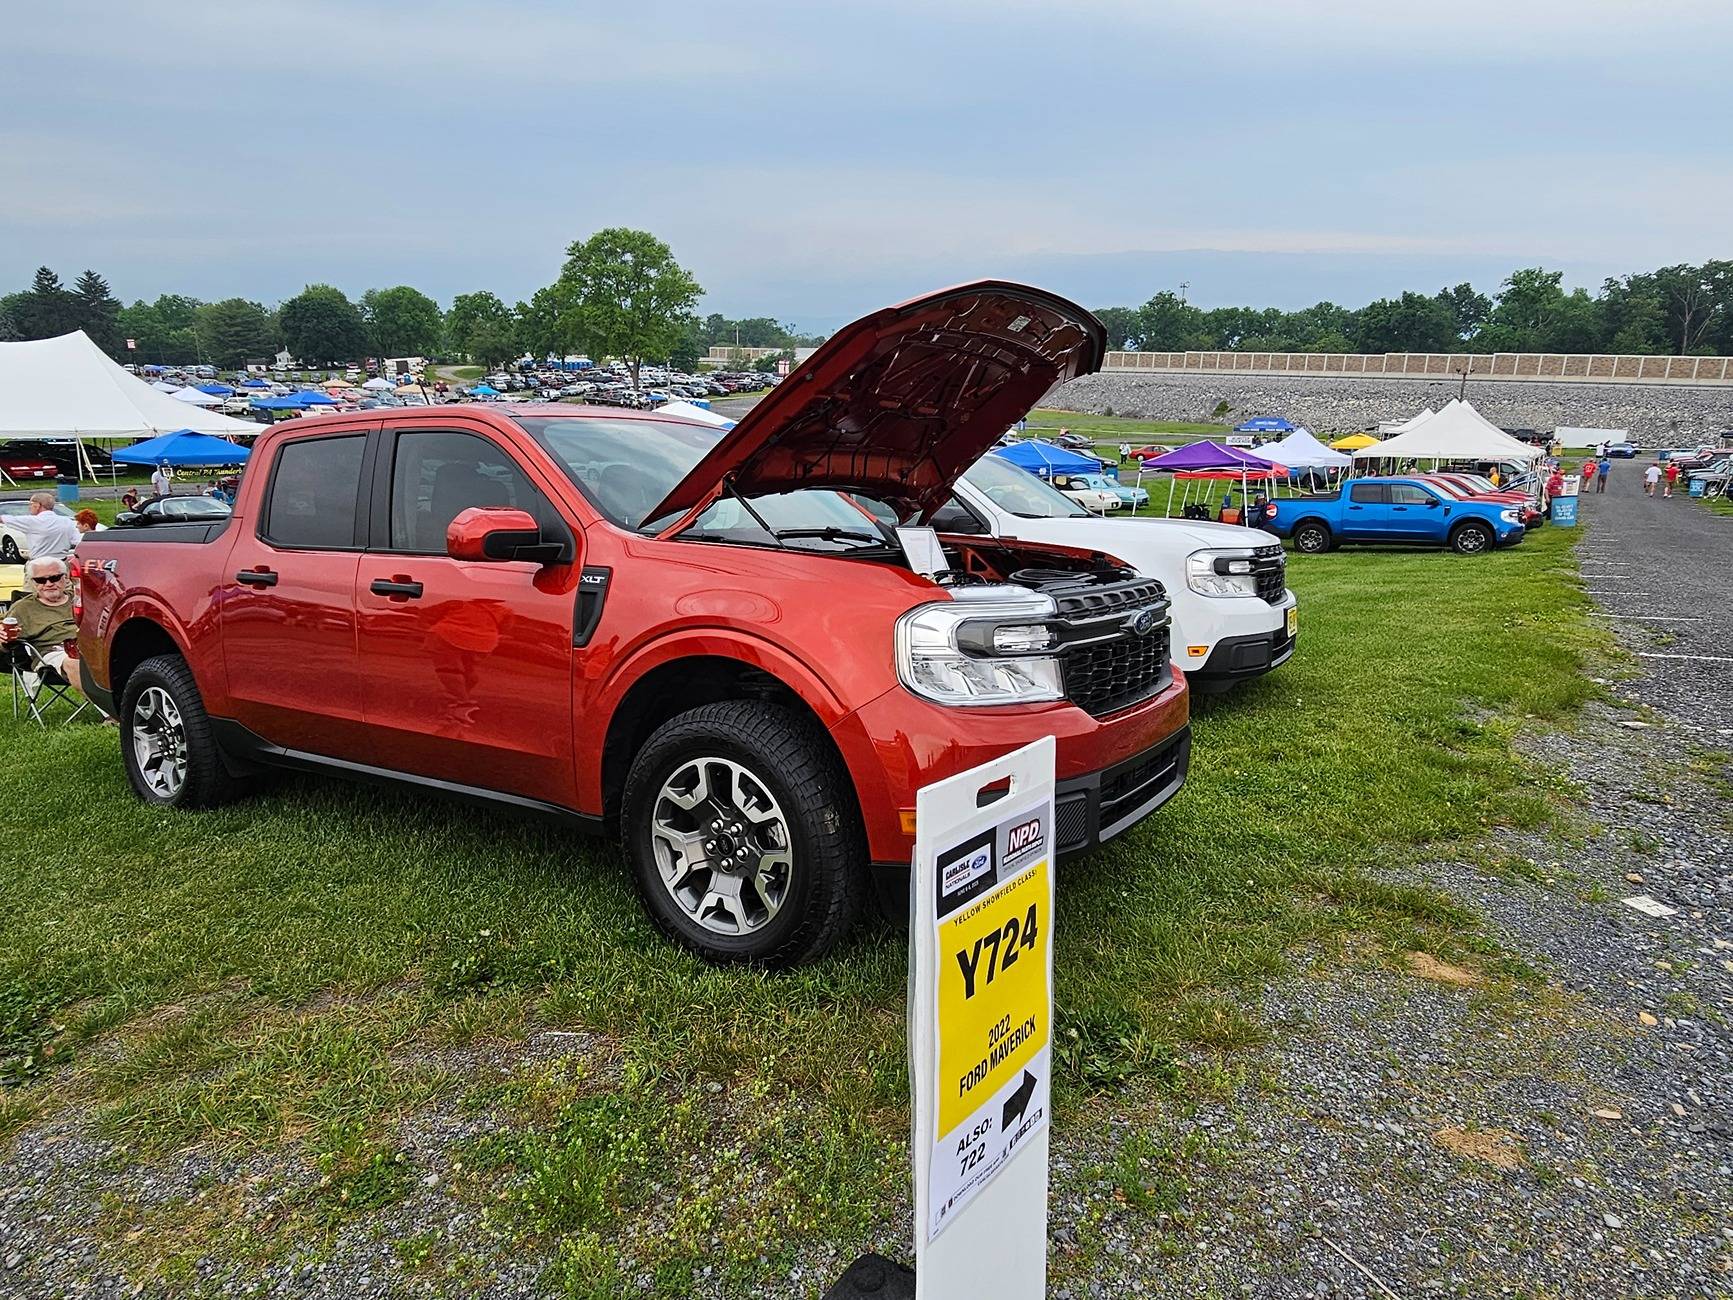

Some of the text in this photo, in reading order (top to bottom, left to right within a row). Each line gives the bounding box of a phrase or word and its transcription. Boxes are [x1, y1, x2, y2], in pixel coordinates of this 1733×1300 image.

[177, 468, 202, 477] Central
[84, 559, 118, 574] FX4
[580, 575, 605, 584] XLT
[945, 872, 970, 889] NATIONALS
[946, 859, 970, 880] CARLISLE
[954, 904, 981, 927] YELLOW
[982, 882, 1016, 909] SHOWFIELD
[1018, 870, 1037, 886] CLASS:
[956, 902, 1038, 1000] Y724
[988, 1014, 1010, 1048] 2022
[960, 1014, 1036, 1098] FORD MAVERICK
[956, 1117, 992, 1156] ALSO:
[960, 1142, 986, 1177] 722
